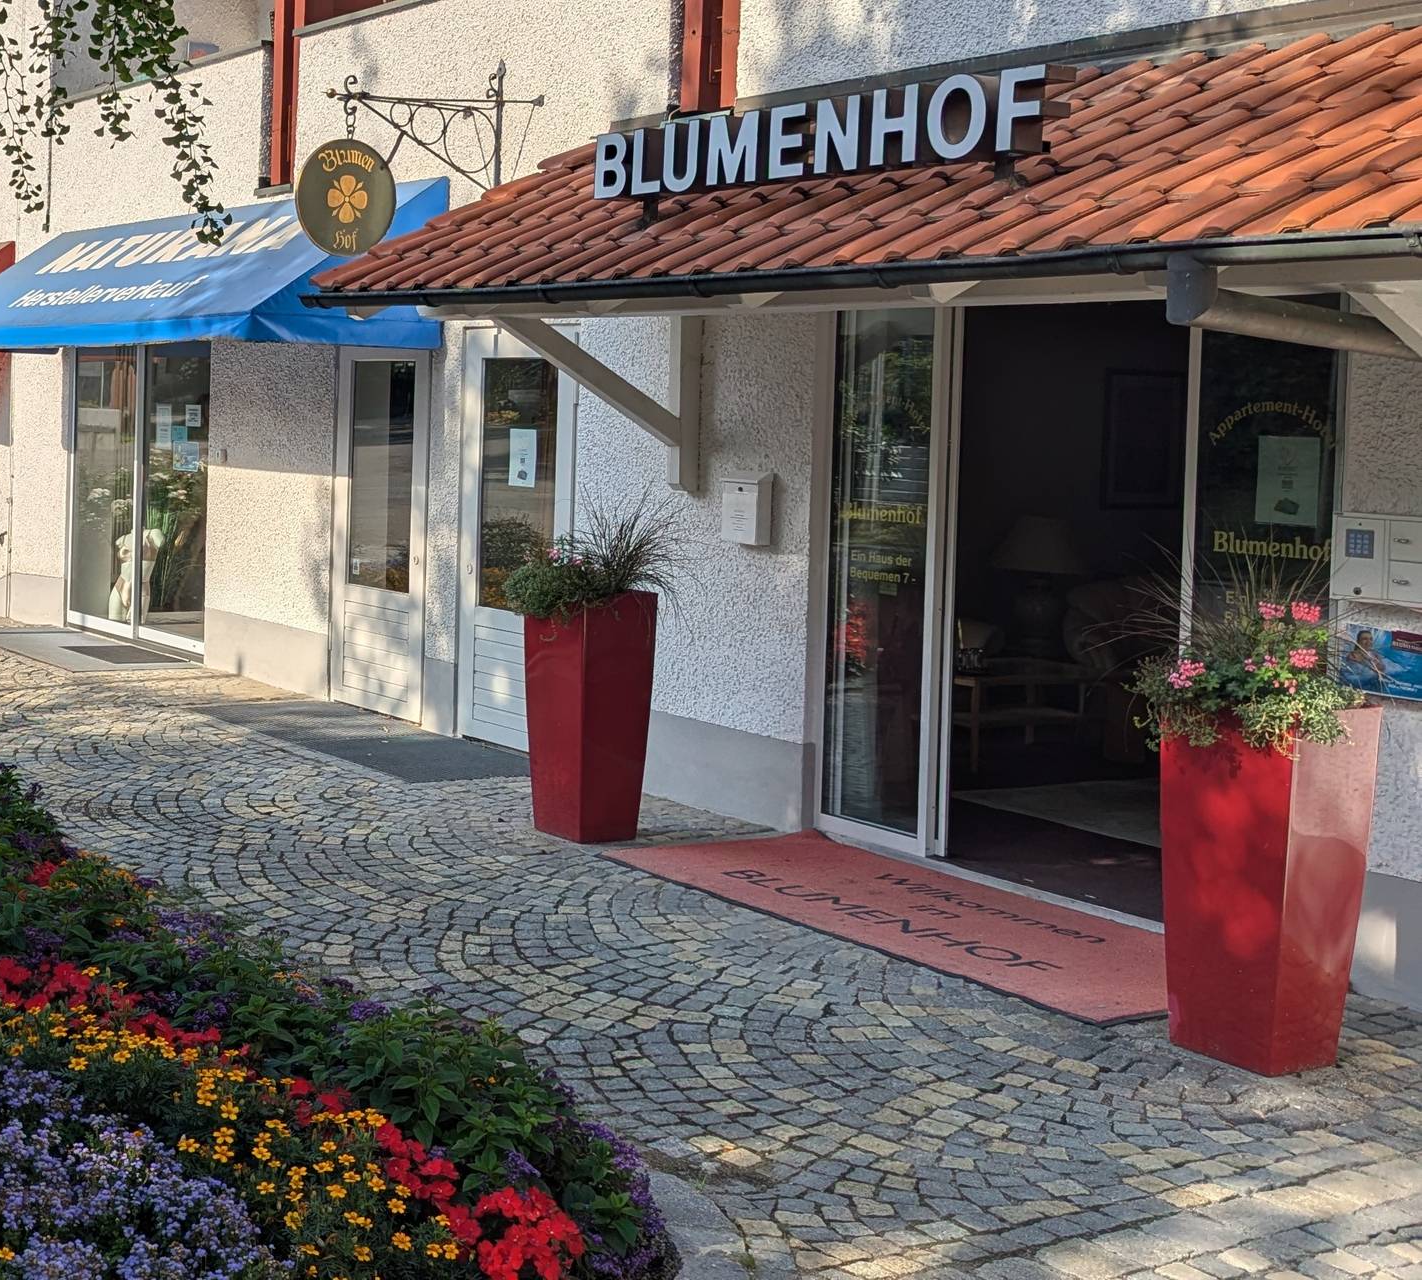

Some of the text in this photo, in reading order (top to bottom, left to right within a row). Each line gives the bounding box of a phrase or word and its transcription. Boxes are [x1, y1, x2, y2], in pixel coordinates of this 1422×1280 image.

[593, 63, 1047, 200] BLUMENHOF
[318, 148, 375, 172] Blumen
[332, 227, 359, 252] Hof
[9, 274, 209, 309] Herstellerverkauf
[841, 502, 923, 524] Blumenhof
[851, 550, 912, 567] Ein Haus der
[1212, 529, 1331, 561] Blumenhof
[721, 868, 1063, 971] BLUMENHOF
[875, 873, 1107, 944] Willkommen
[909, 904, 961, 920] im
